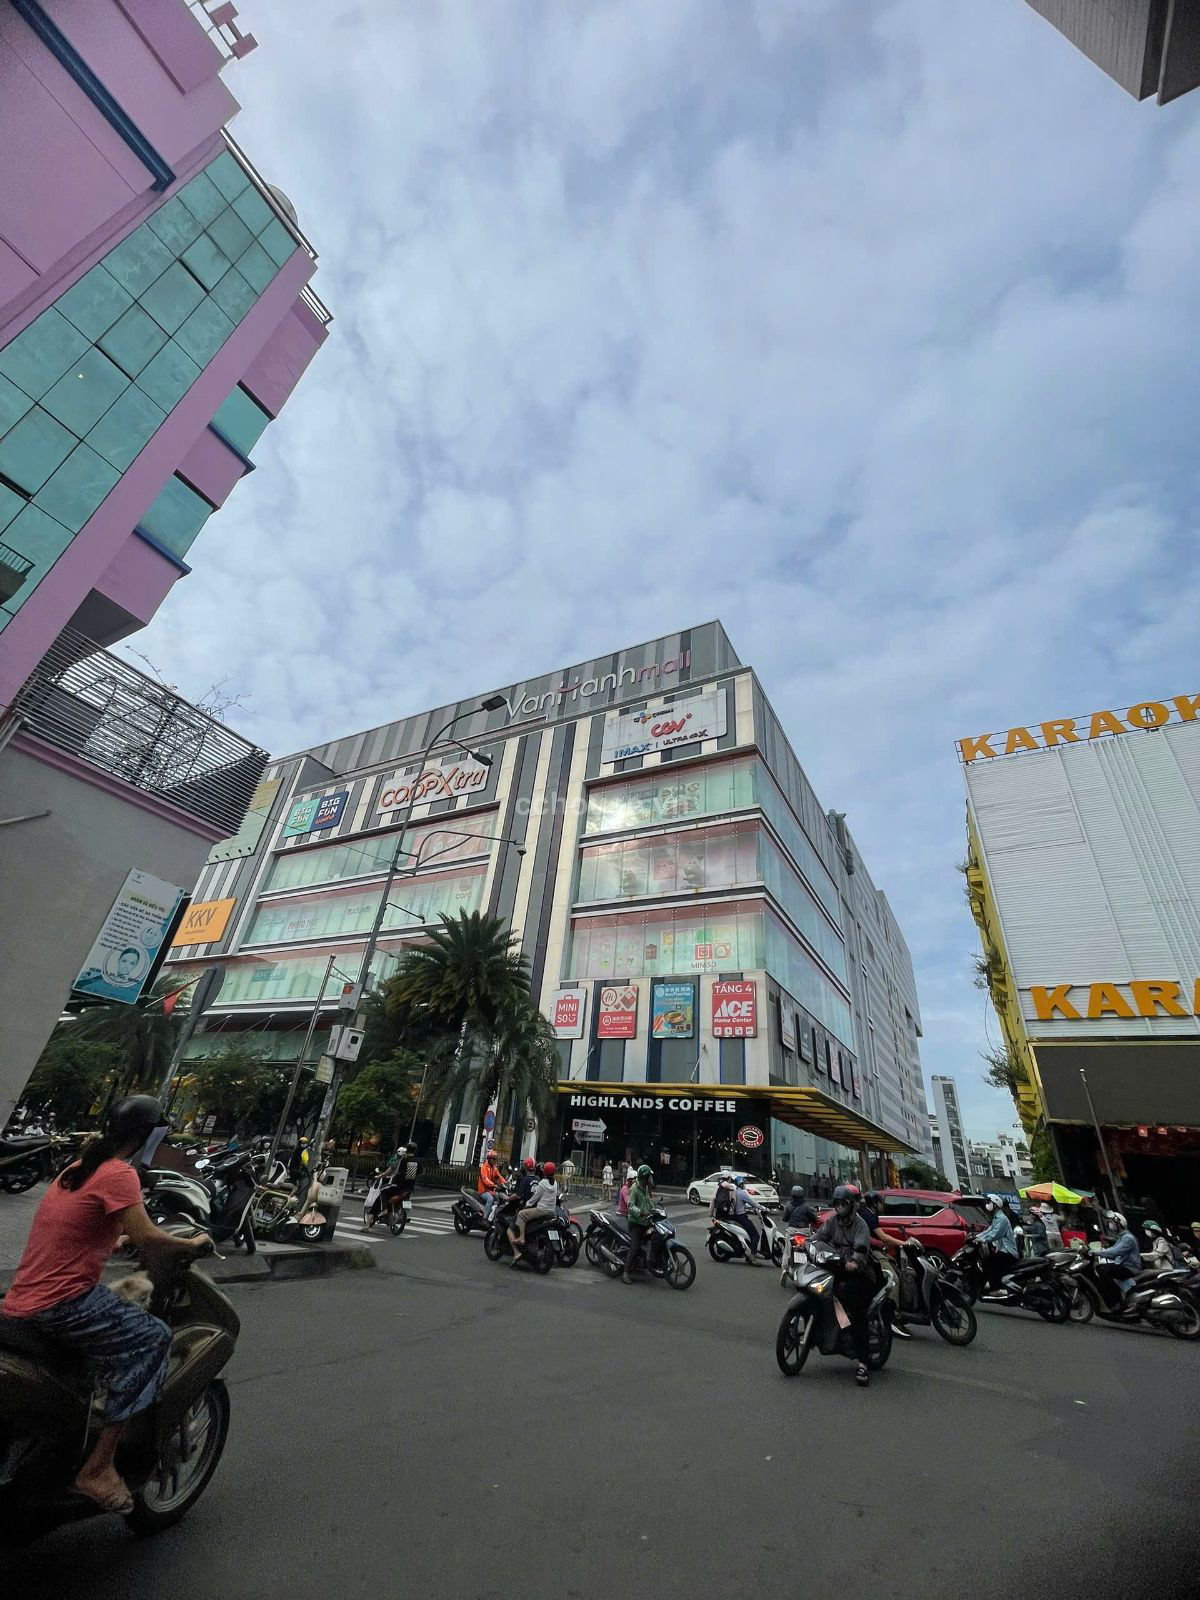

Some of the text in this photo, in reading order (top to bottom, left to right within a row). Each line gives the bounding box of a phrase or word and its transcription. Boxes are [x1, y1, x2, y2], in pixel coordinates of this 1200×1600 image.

[650, 717, 686, 738] CGV
[614, 743, 652, 758] IMAX
[321, 796, 341, 809] BIG
[185, 906, 218, 929] KKV
[744, 984, 752, 993] 4
[558, 1003, 577, 1012] MINI
[714, 998, 753, 1018] ACE
[1030, 979, 1200, 1020] KAR
[570, 1095, 736, 1113] HIGHLANDS COFFEE
